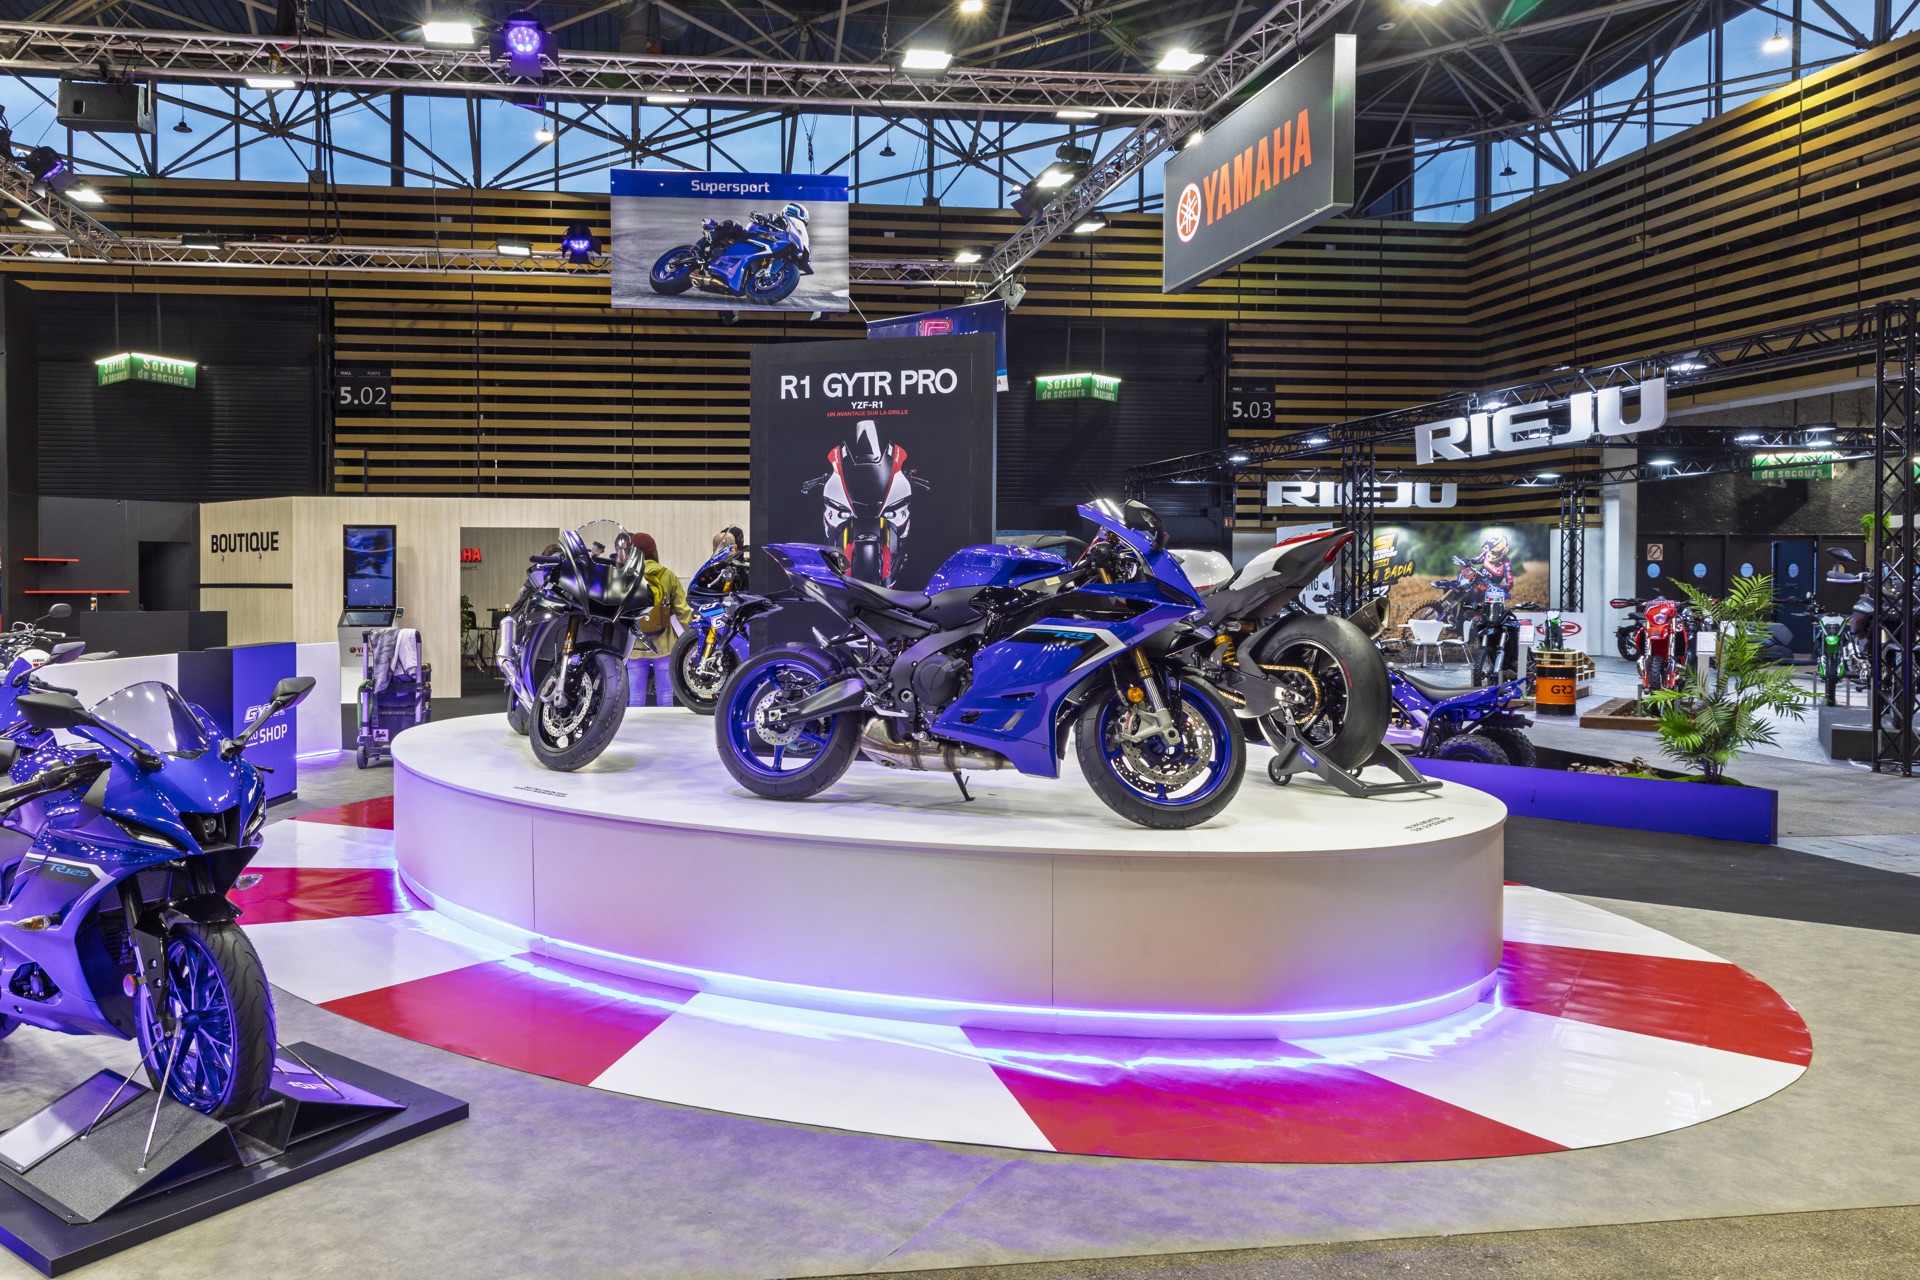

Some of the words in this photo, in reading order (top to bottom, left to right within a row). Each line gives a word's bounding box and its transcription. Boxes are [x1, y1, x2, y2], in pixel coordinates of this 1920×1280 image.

[1202, 108, 1312, 227] YAMAHA
[691, 180, 770, 195] Supersport
[104, 360, 126, 374] Sortie
[143, 359, 185, 375] Sortie
[137, 369, 148, 379] de
[151, 372, 188, 386] secours
[780, 375, 810, 400] R1
[823, 371, 892, 398] GYTR
[900, 368, 958, 395] PRO
[1047, 378, 1082, 390] Sortie
[340, 386, 387, 405] 5.02
[1042, 390, 1052, 399] de
[1054, 389, 1086, 398] secours
[851, 401, 883, 409] YZF-R1
[1232, 401, 1272, 418] 5.03
[1415, 377, 1667, 465] RIEJU
[1761, 470, 1775, 479] de
[1778, 468, 1823, 478] secours
[1267, 481, 1457, 508] RIEJU
[211, 531, 279, 553] BOUTIQUE
[1384, 561, 1414, 580] BADIA
[260, 724, 288, 744] SHOP
